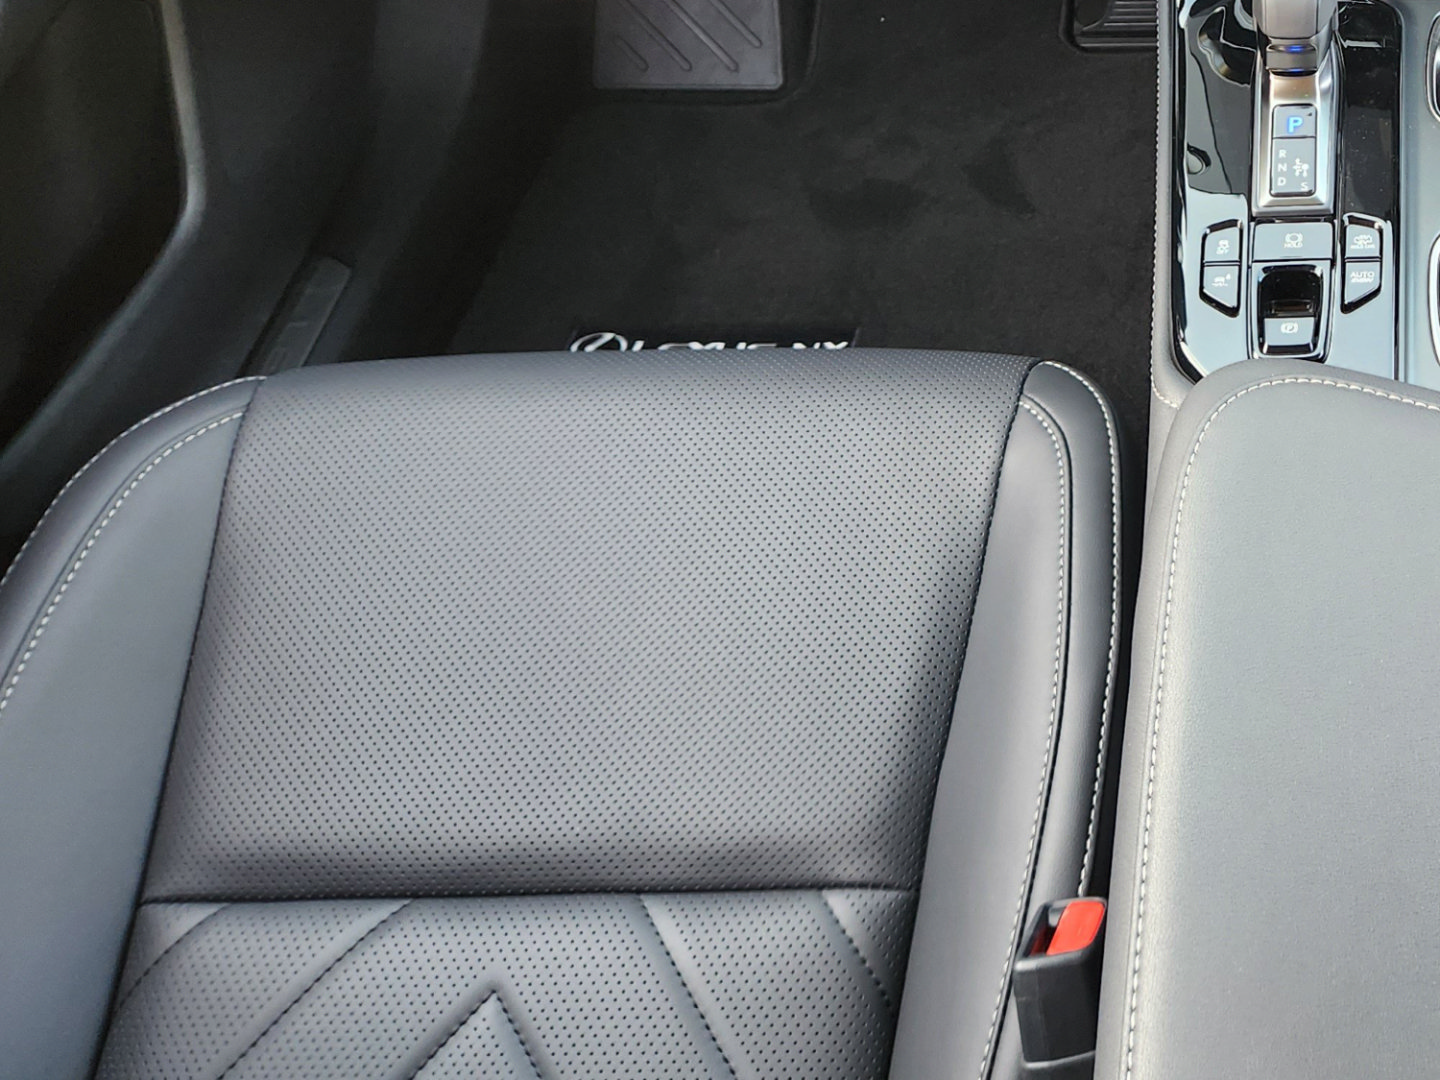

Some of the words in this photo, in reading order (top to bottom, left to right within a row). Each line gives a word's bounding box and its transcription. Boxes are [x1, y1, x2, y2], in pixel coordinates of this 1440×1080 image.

[1287, 116, 1304, 134] P
[1278, 149, 1287, 159] R
[1277, 163, 1288, 172] N
[1277, 176, 1287, 186] D
[1300, 182, 1309, 191] S
[1350, 270, 1375, 278] AUTO
